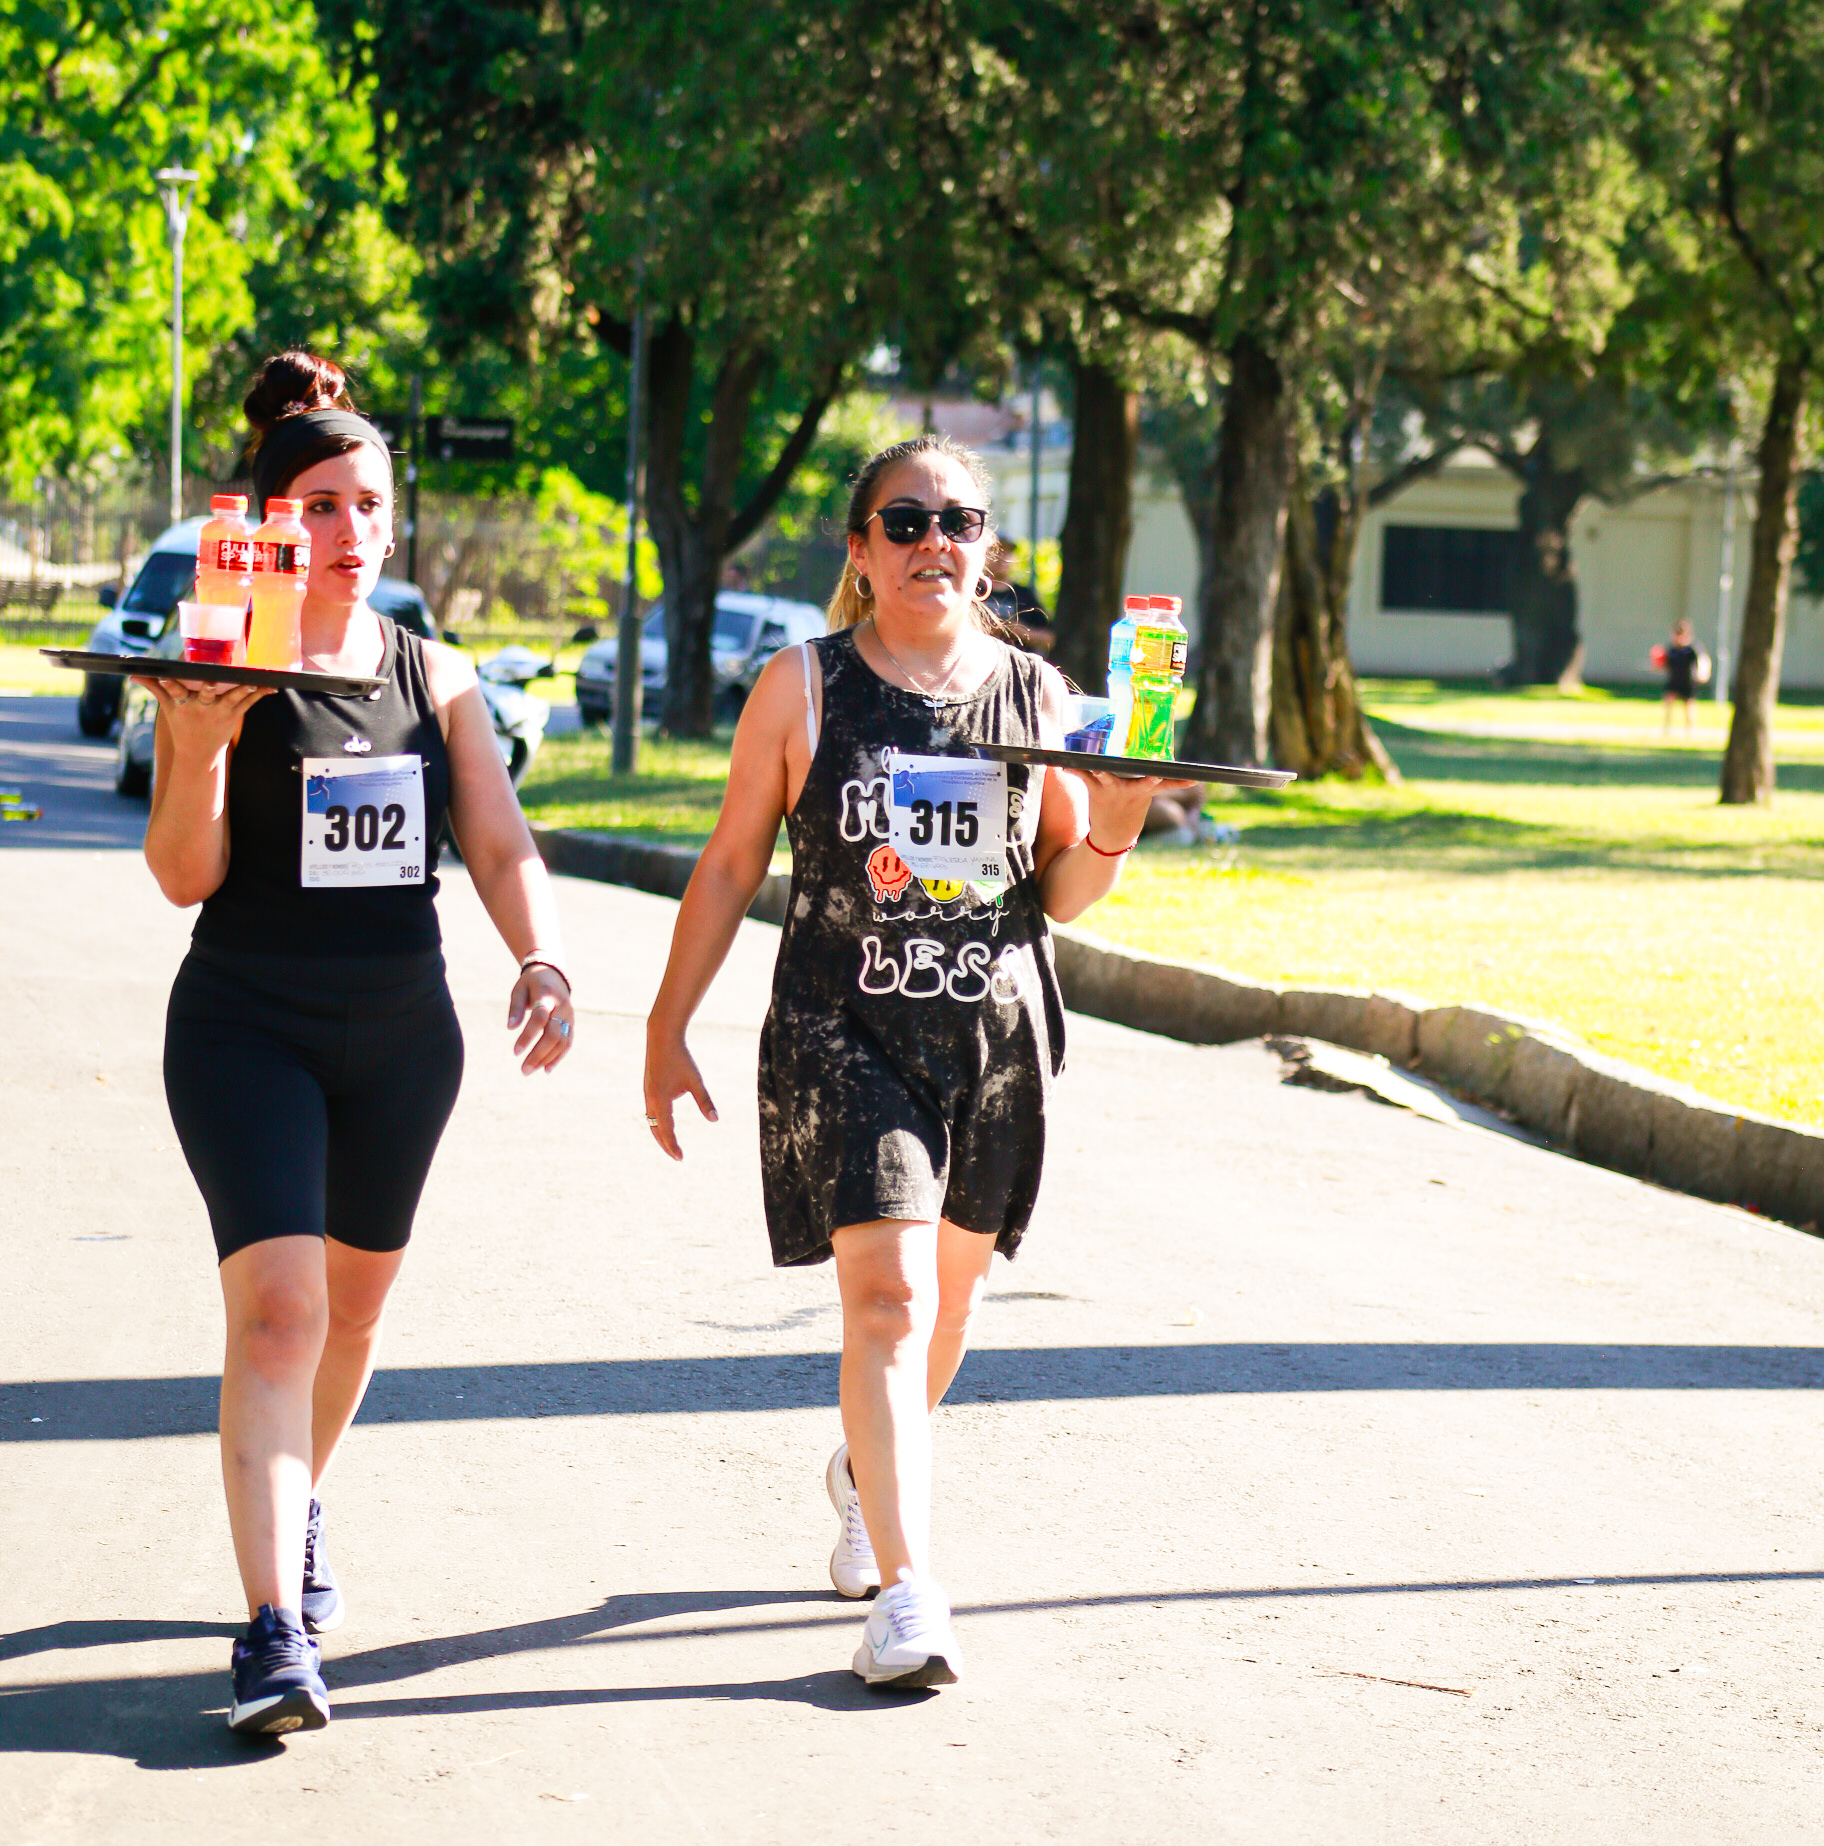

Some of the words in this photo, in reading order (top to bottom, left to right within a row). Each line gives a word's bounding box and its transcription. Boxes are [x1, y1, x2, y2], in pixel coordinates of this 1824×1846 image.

[324, 803, 406, 852] 302
[909, 799, 979, 847] 315
[399, 865, 420, 879] 302
[981, 863, 1000, 876] 315
[872, 906, 1010, 937] worry
[858, 935, 1027, 1004] LESS
